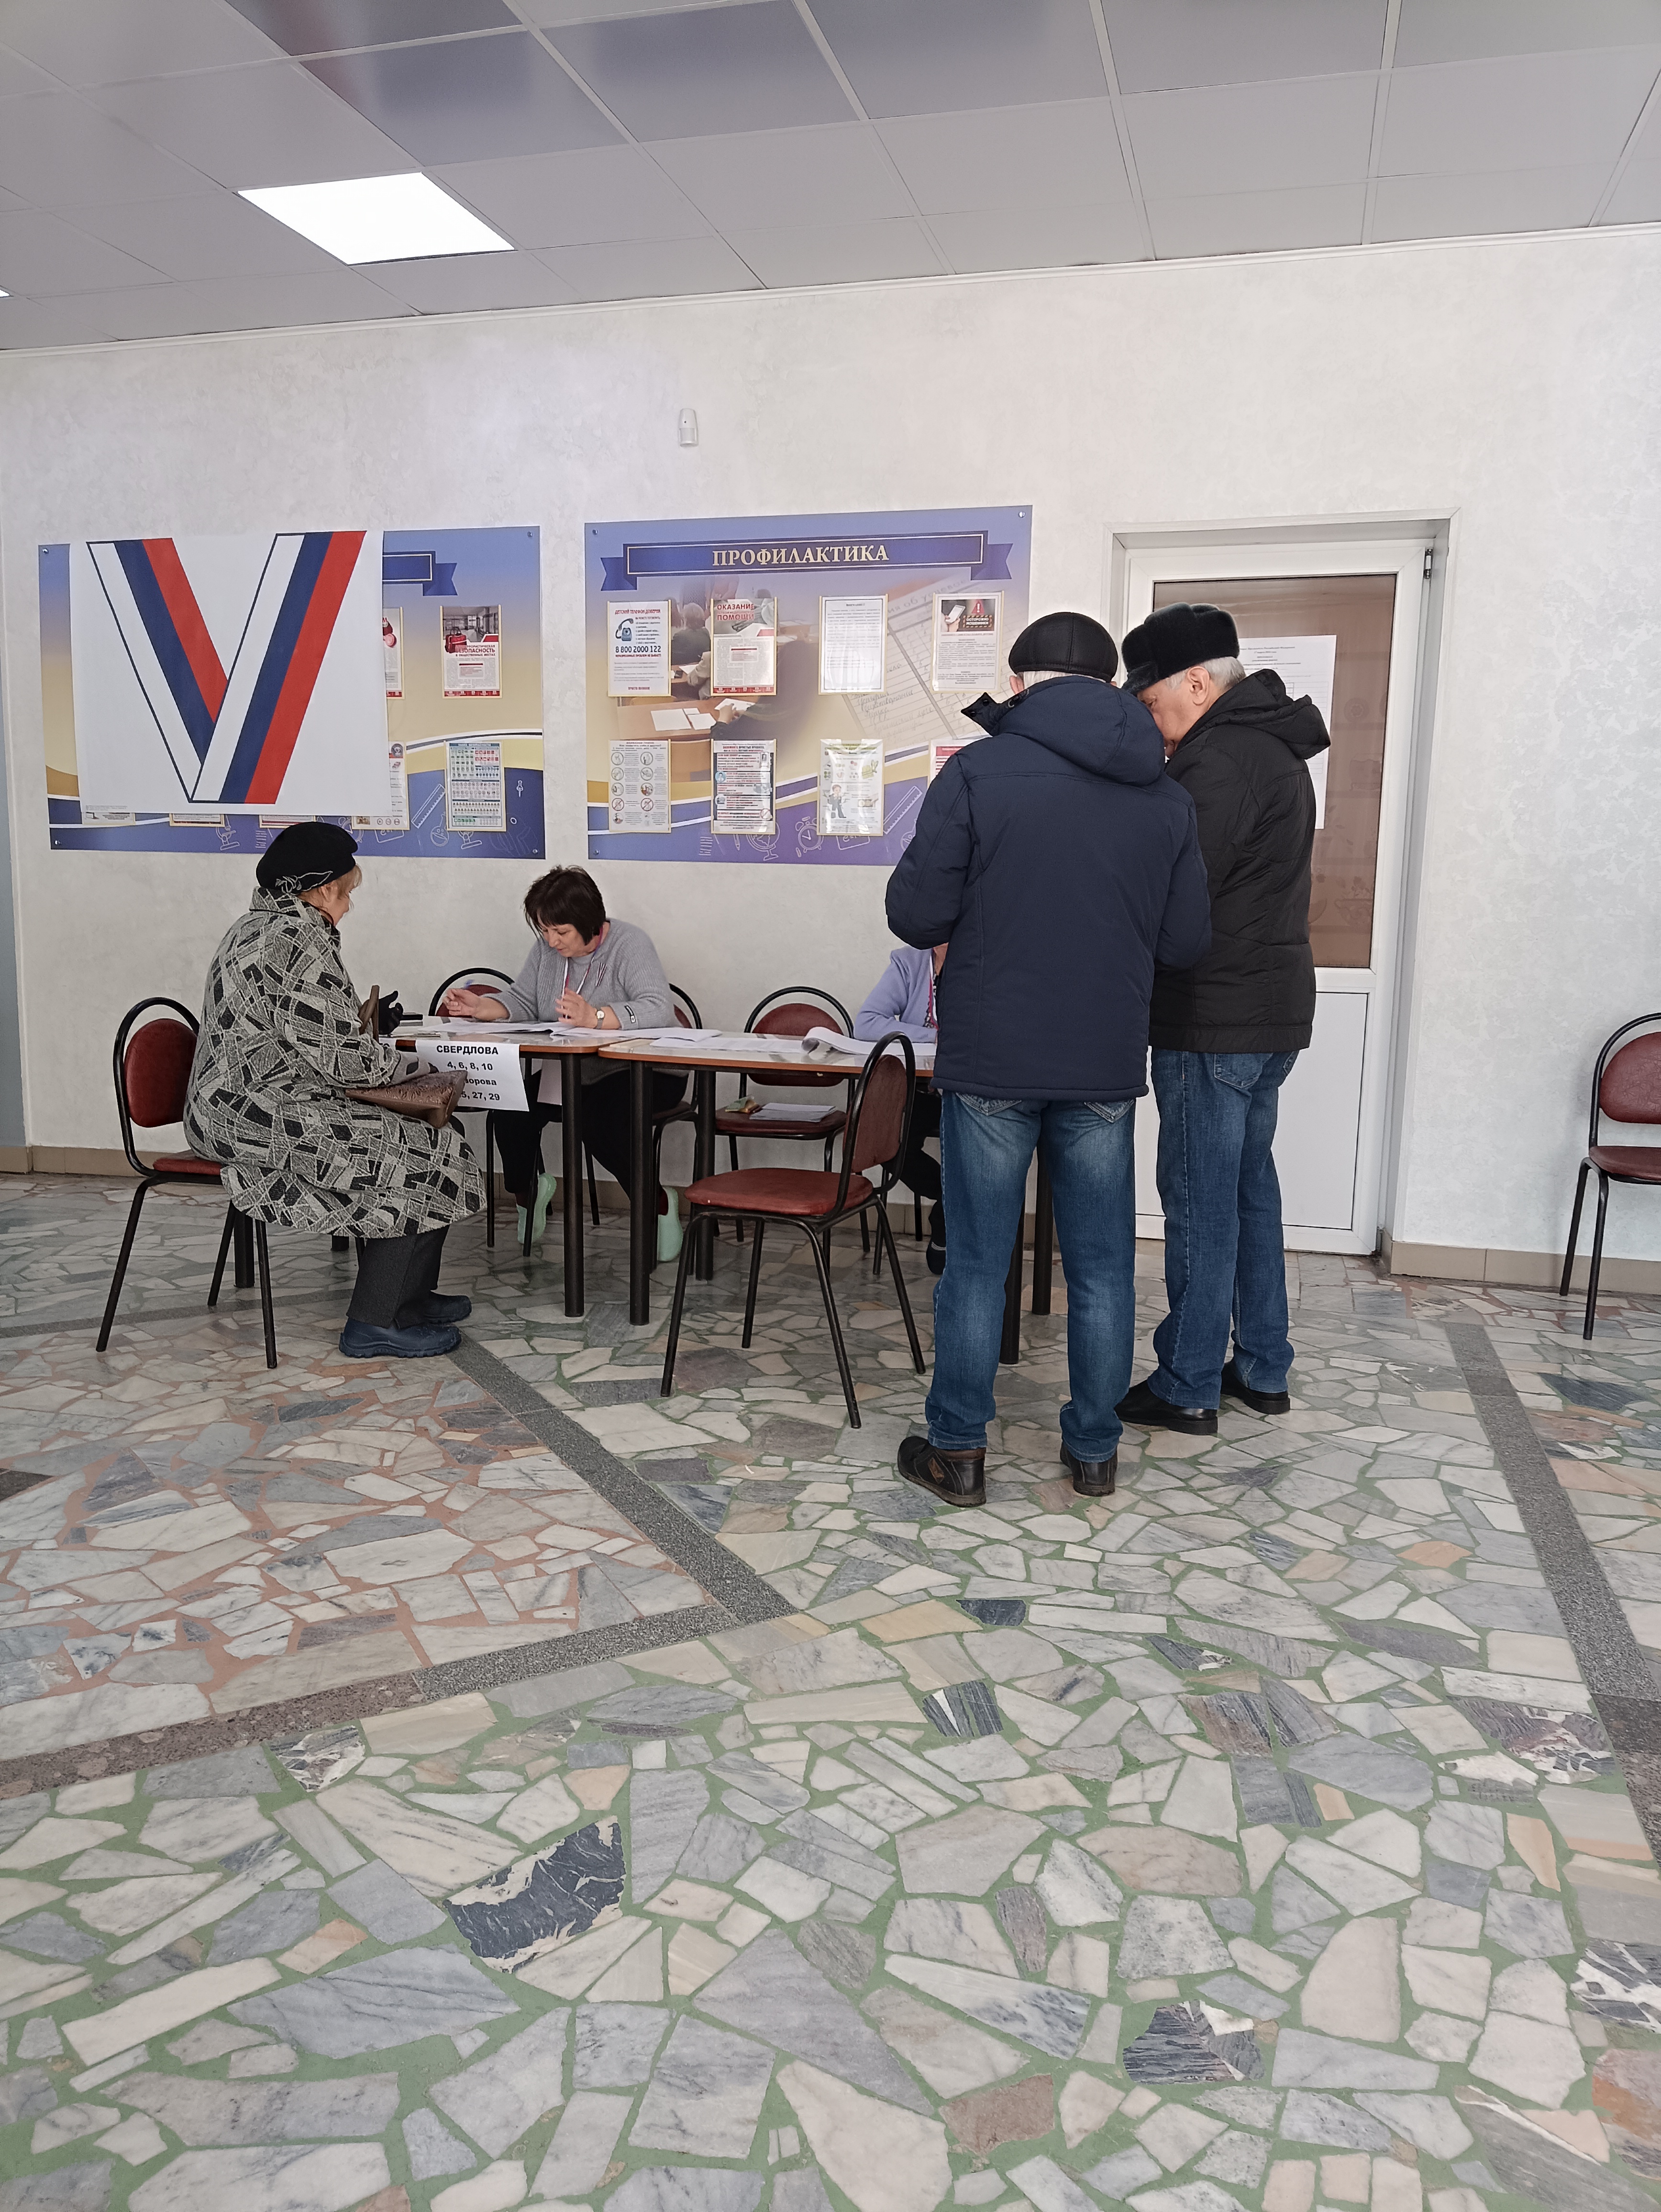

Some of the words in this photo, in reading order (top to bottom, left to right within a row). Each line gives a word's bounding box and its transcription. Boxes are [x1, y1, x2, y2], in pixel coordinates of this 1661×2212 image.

[712, 544, 889, 566] ПРОФИЛАКТИКА
[436, 1045, 498, 1055] СВЕРДЛОВА
[447, 1062, 456, 1070] 4,
[458, 1062, 468, 1070] 6,
[470, 1062, 479, 1071] 8,
[472, 1092, 487, 1101] 27,
